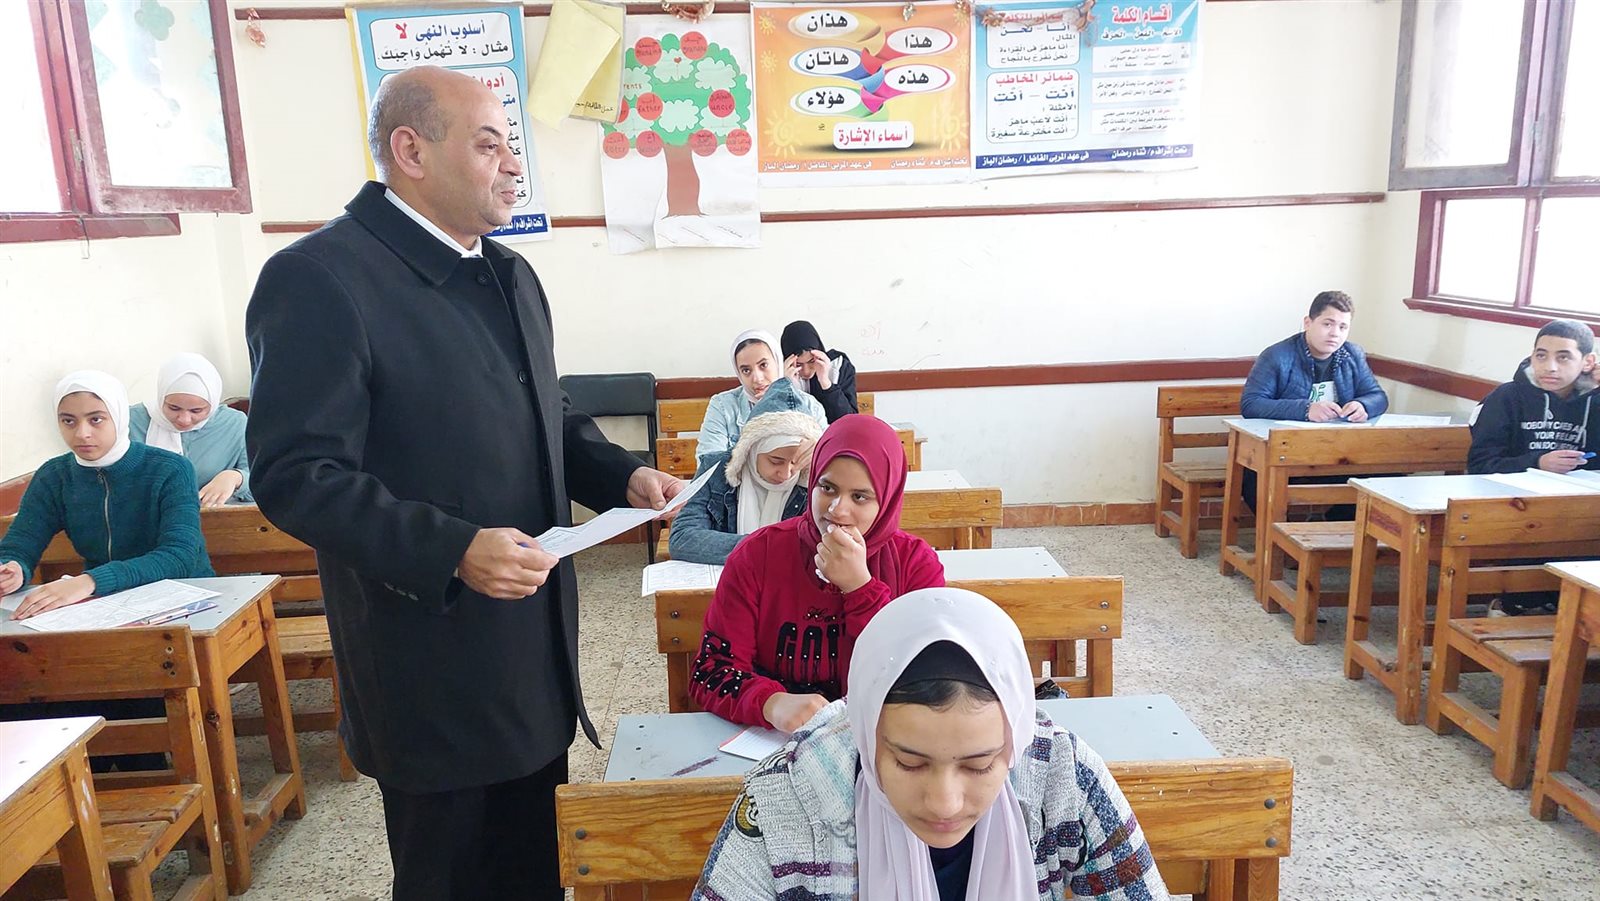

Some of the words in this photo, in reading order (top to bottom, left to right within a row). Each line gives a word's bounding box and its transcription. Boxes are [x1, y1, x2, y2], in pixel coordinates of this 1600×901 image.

[807, 13, 848, 32] هذان
[1113, 7, 1141, 22] الكلمة
[395, 22, 408, 40] لا
[451, 19, 486, 42] أسلوب
[481, 40, 509, 57] مثال
[904, 34, 933, 48] هذا
[458, 45, 468, 55] لا
[805, 51, 849, 70] هاتان
[898, 71, 930, 84] هذه
[995, 73, 1038, 87] المخاطب
[1041, 72, 1074, 84] ضمائر
[807, 90, 845, 108] هؤلاء
[839, 127, 876, 145] الإشارة
[878, 126, 908, 142] أسماء
